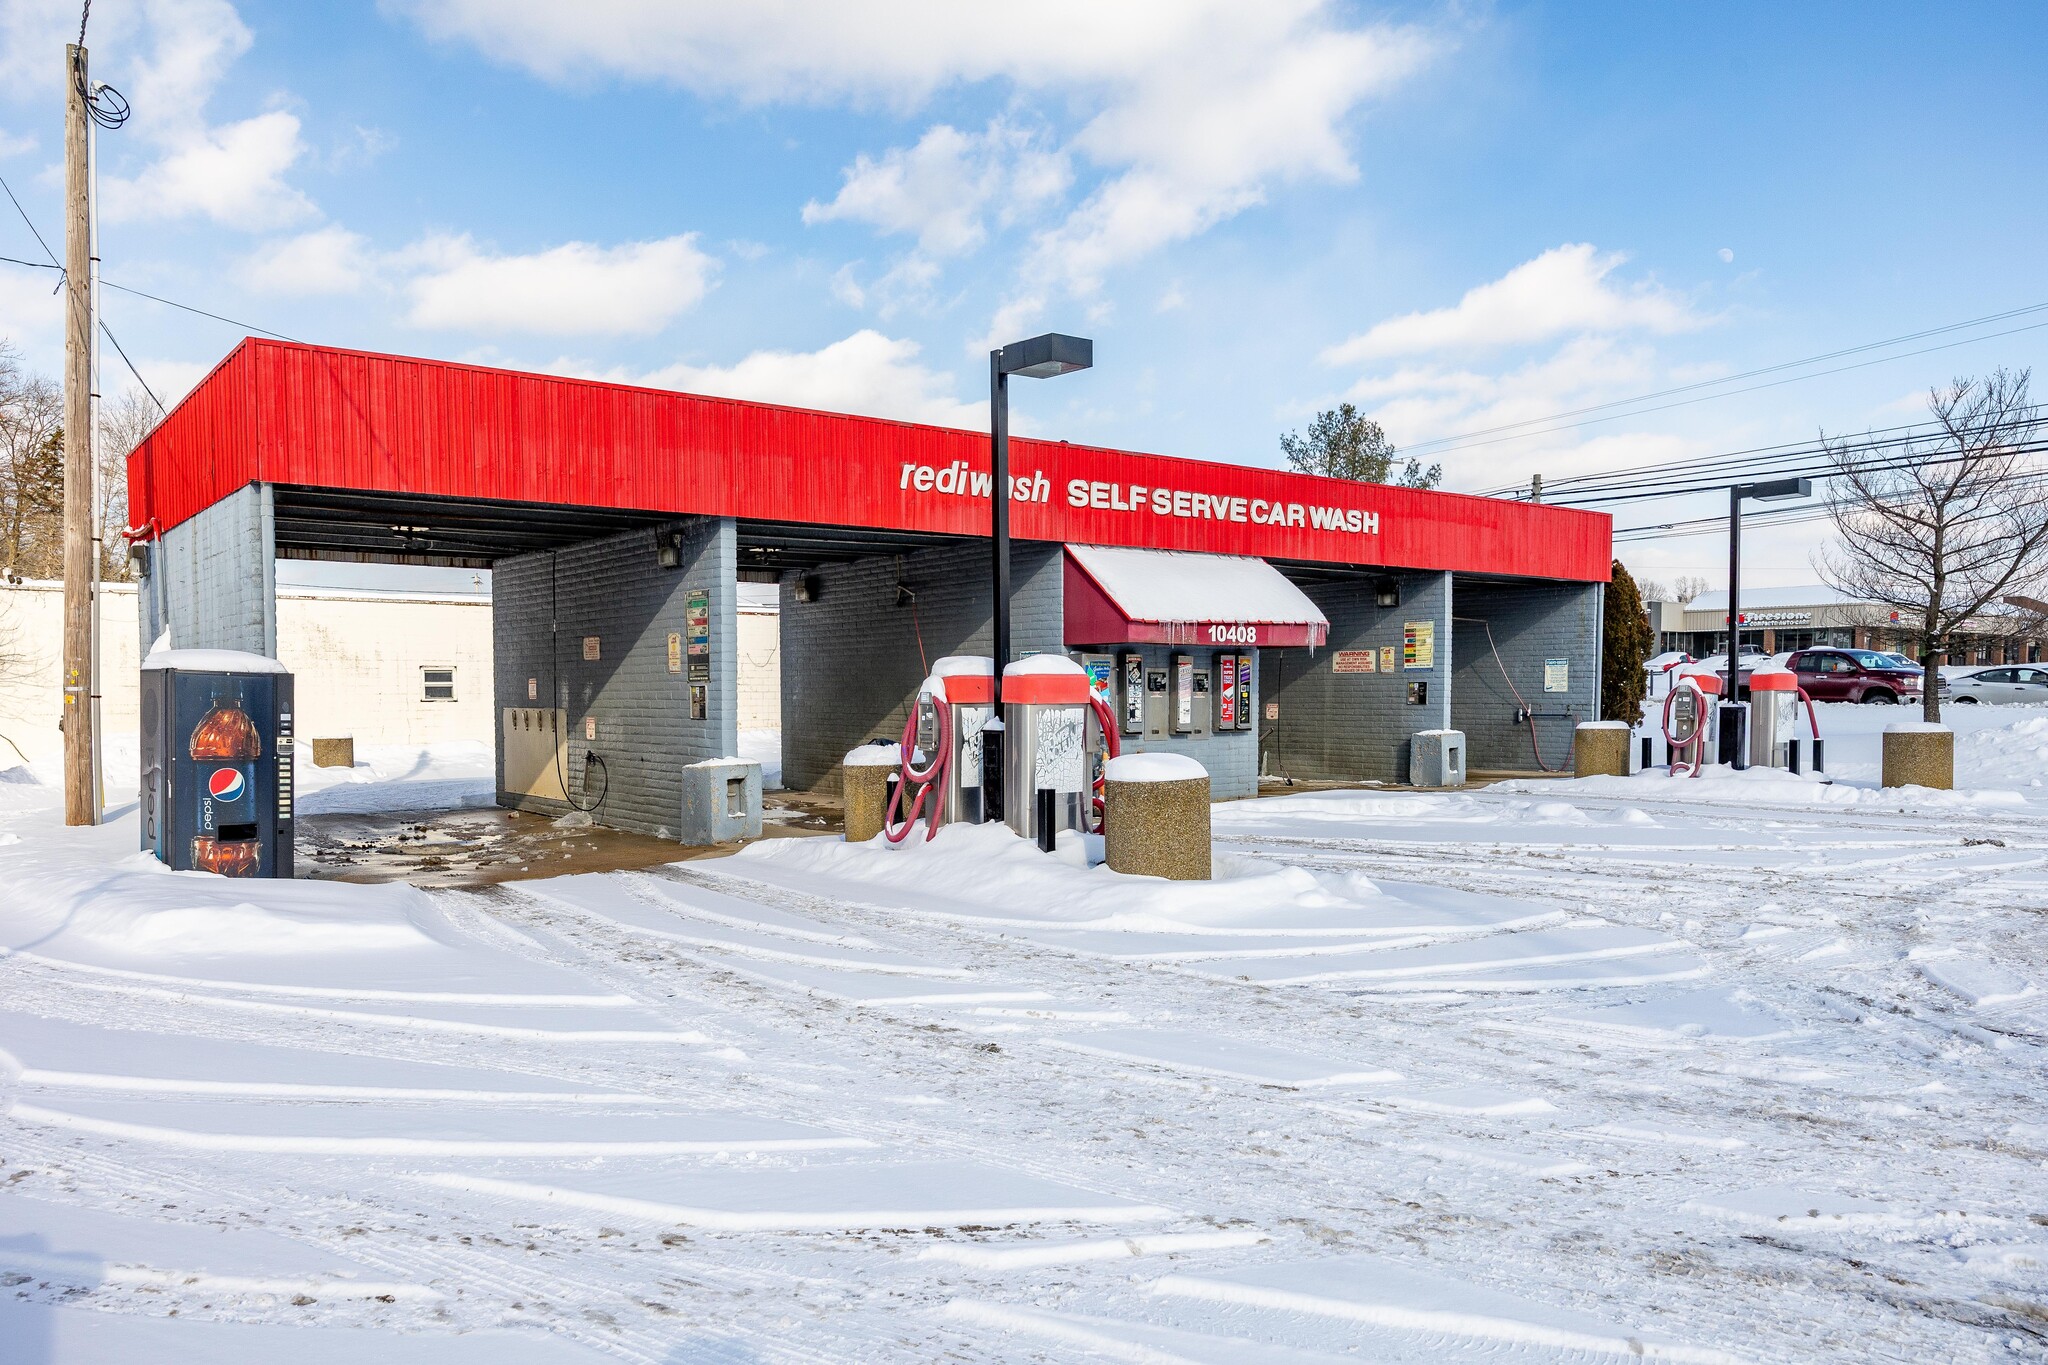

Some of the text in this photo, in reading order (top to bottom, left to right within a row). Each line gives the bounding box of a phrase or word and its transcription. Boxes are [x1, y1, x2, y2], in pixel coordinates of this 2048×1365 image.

[1067, 478, 1379, 535] SELF SERVE CAR WASH
[1746, 612, 1812, 622] Firestone
[1208, 625, 1257, 643] 10408
[147, 746, 157, 840] pepsi
[203, 798, 214, 830] pepsi
